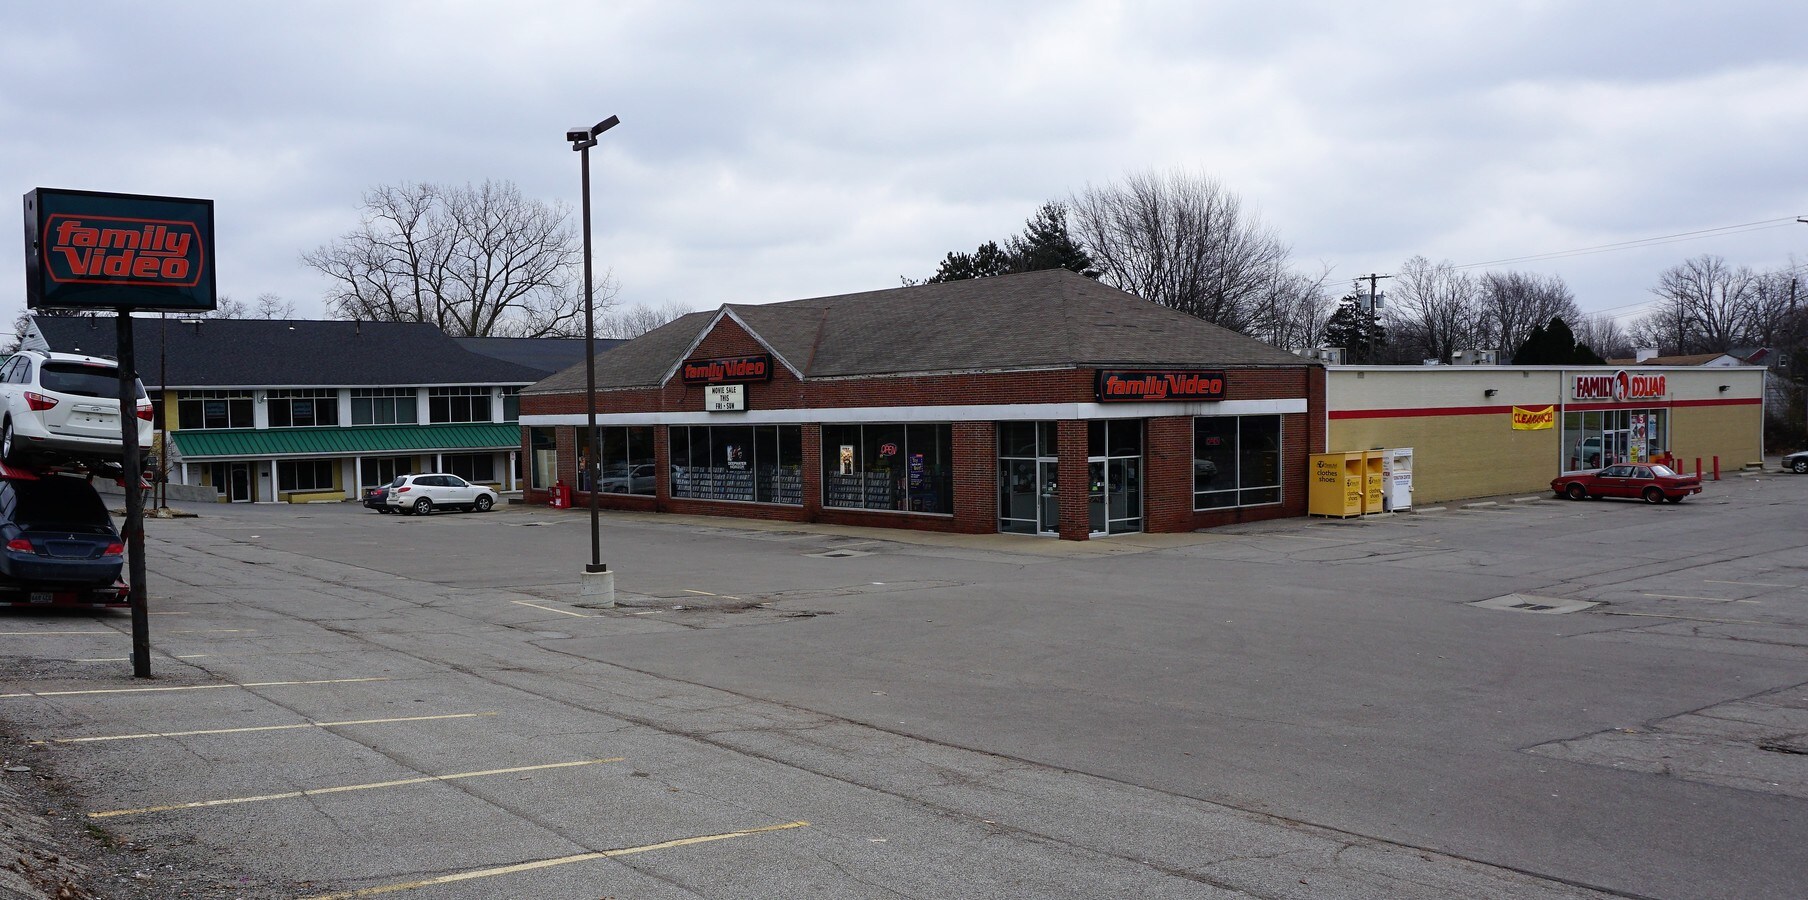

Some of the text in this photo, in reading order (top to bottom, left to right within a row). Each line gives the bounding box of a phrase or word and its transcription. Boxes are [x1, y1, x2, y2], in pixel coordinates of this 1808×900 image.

[56, 221, 191, 257] family
[53, 247, 189, 279] Video
[685, 360, 764, 382] family Video
[1106, 374, 1222, 398] family Video
[1576, 374, 1666, 398] FAMILY DOLLAR
[1514, 411, 1553, 425] CLEARANCE!
[880, 444, 896, 454] OPEN
